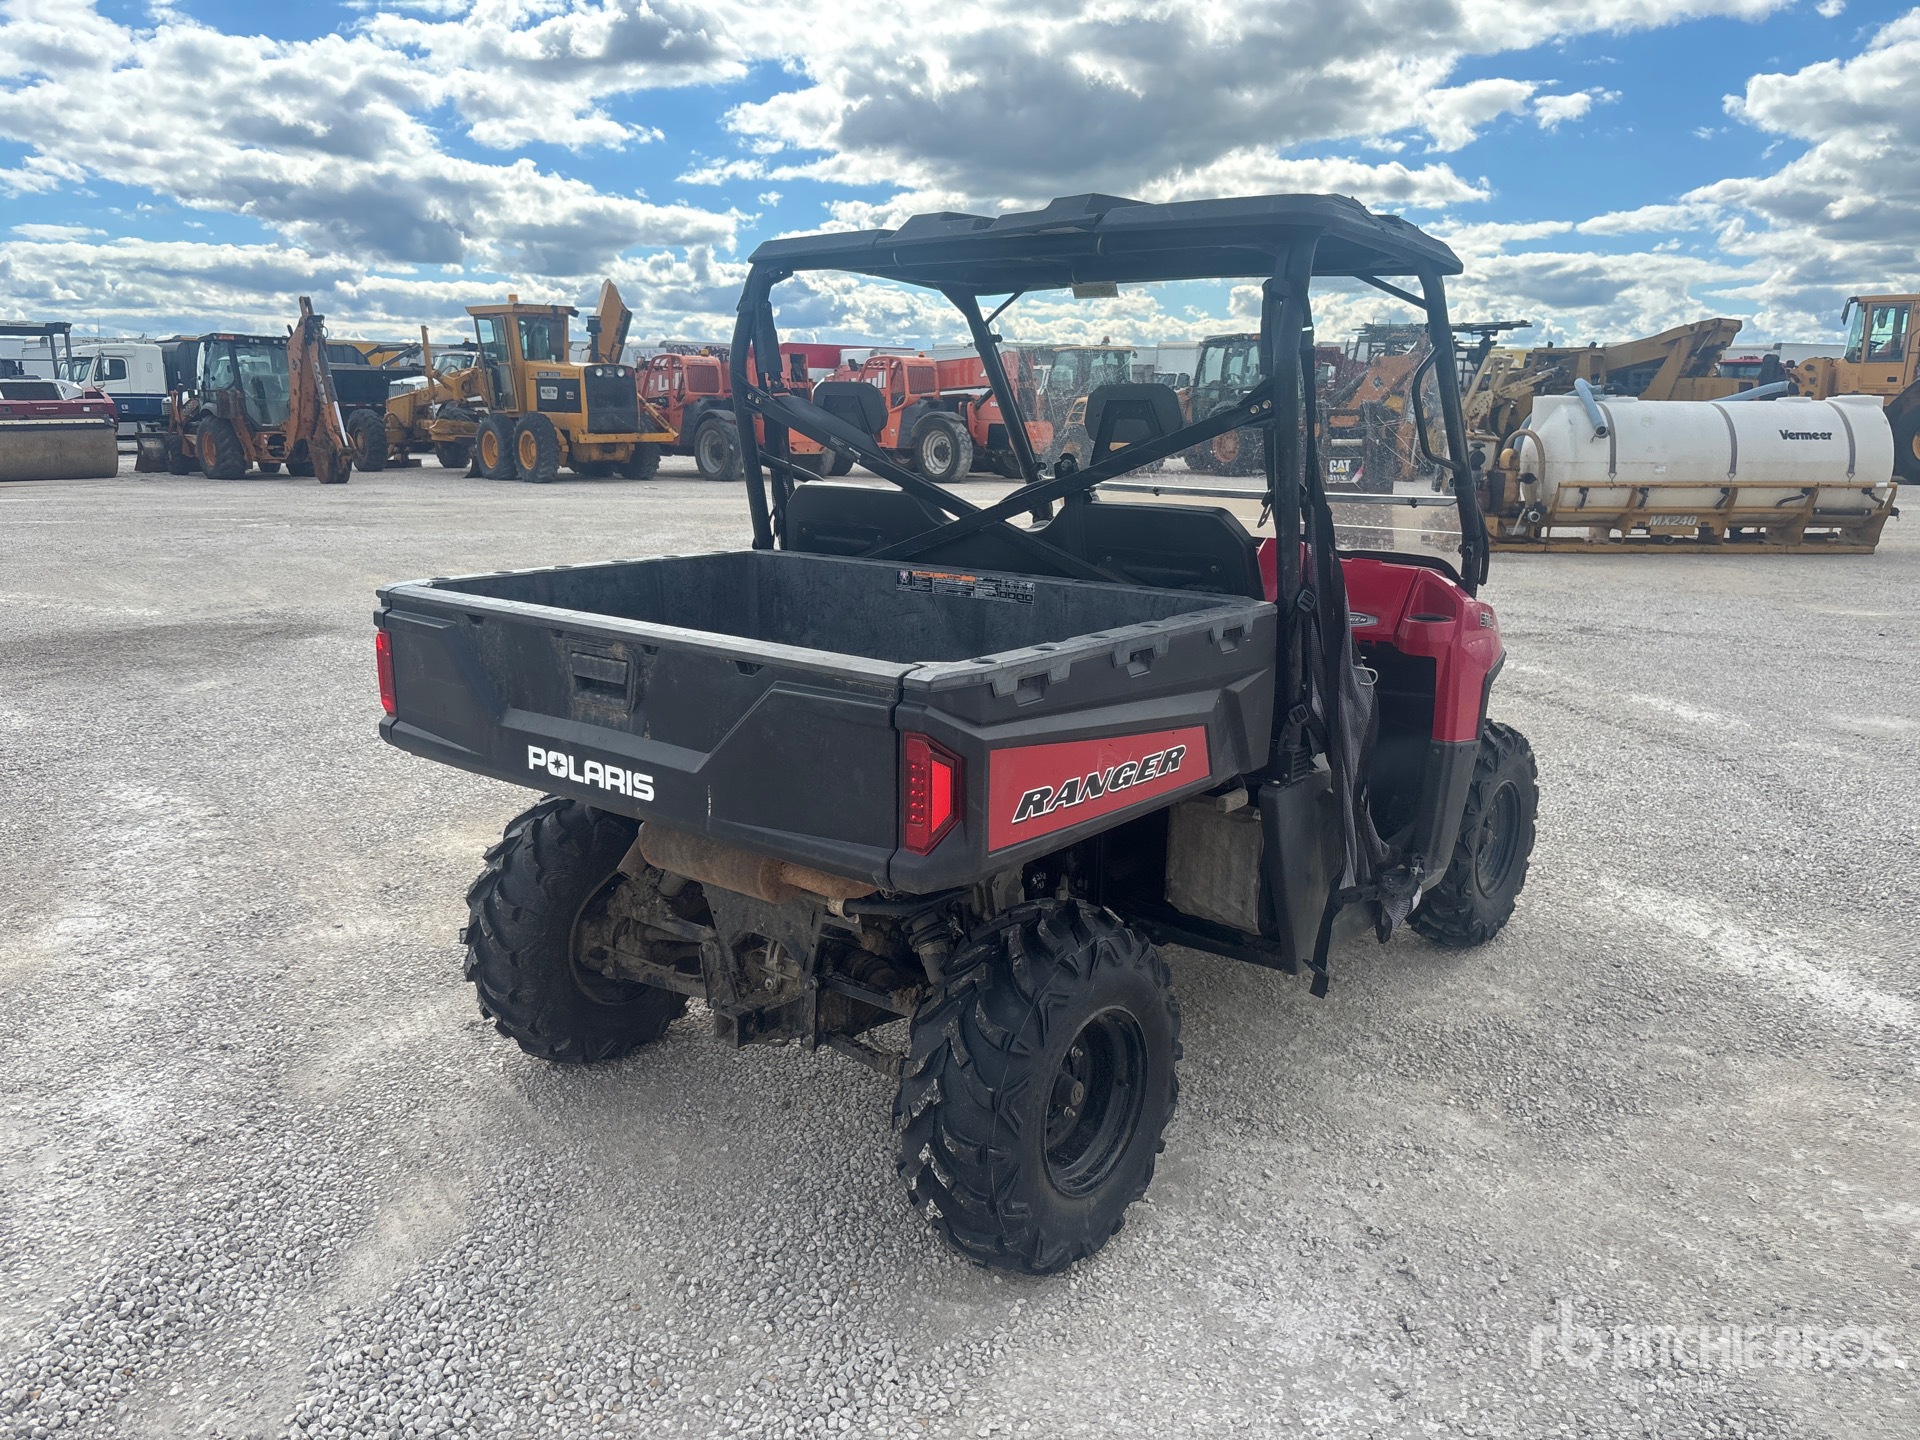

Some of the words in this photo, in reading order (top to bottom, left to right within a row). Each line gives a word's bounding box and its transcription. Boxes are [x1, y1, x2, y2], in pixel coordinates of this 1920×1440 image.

[1778, 429, 1833, 441] Vermeer
[1329, 459, 1352, 473] CAT
[1648, 515, 1698, 526] MX240
[527, 744, 655, 802] POLARIS
[1011, 744, 1187, 825] RANGER
